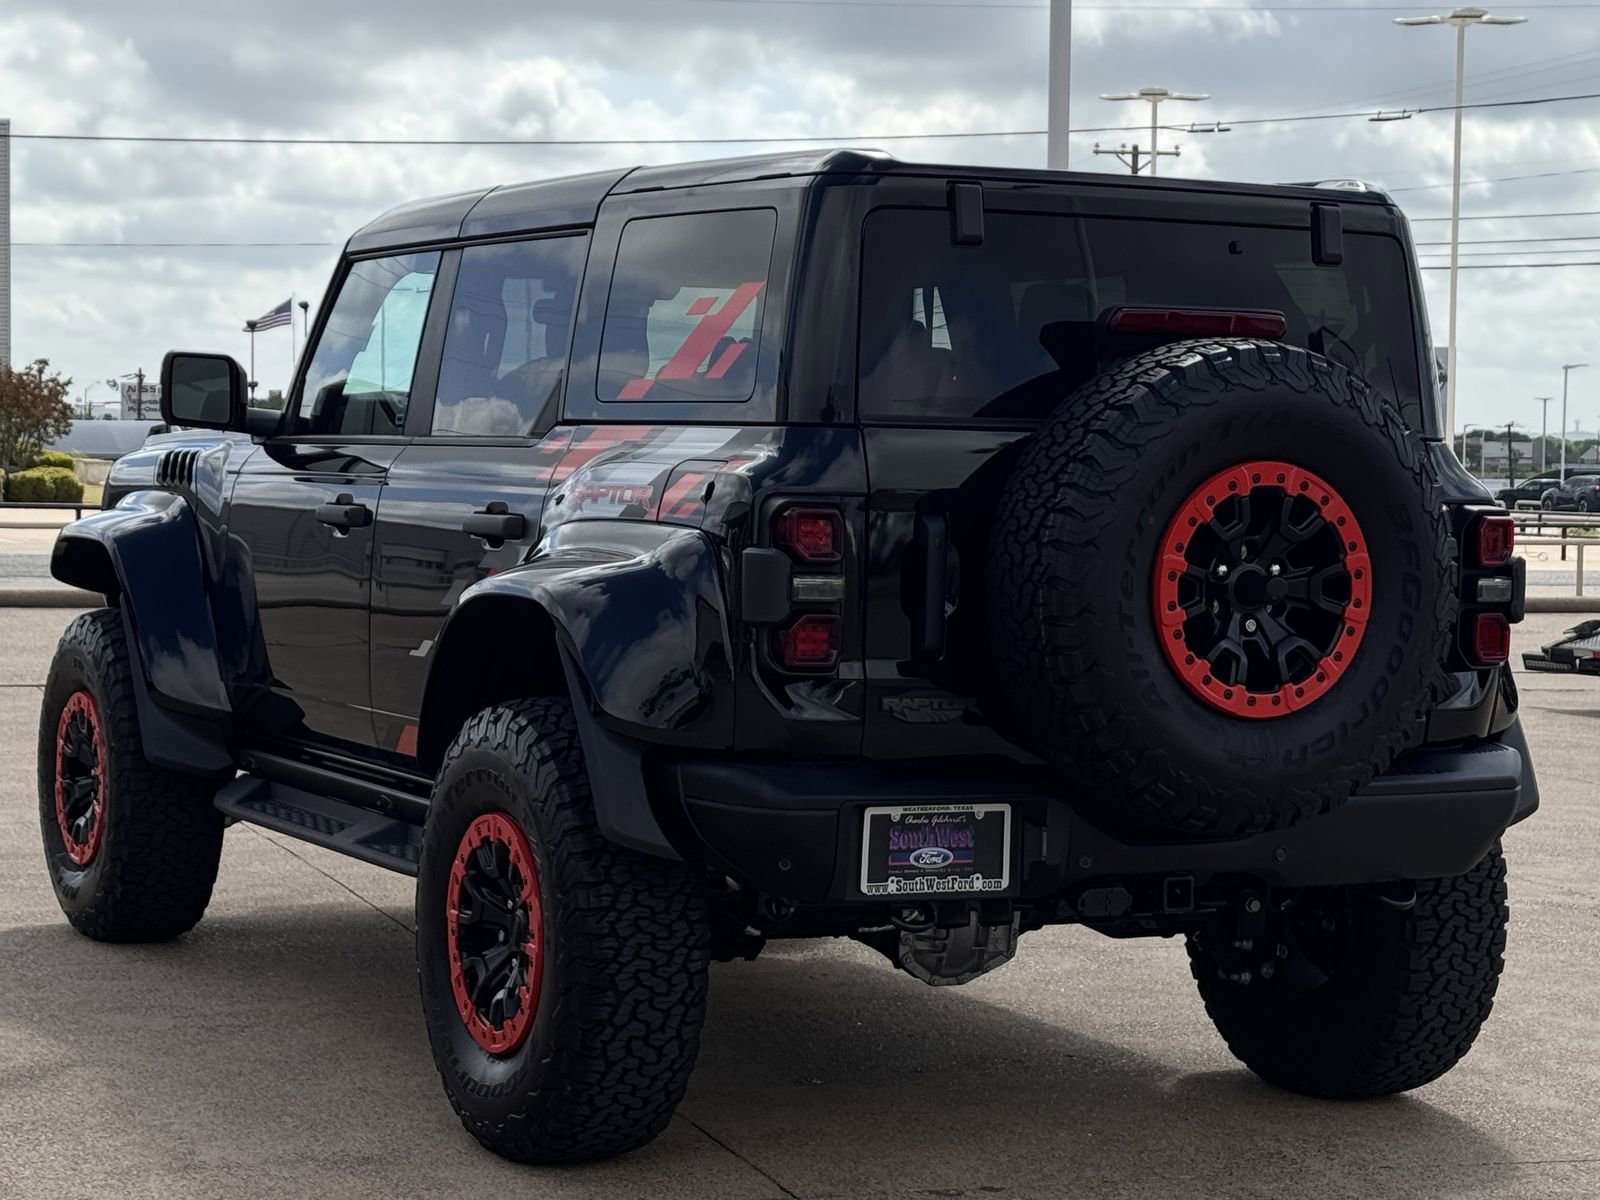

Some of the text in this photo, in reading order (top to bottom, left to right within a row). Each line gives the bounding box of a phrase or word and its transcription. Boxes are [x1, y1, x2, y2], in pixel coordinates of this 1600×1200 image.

[574, 484, 654, 512] RAPTOR
[888, 825, 975, 850] SouthWest
[918, 851, 944, 864] Ford
